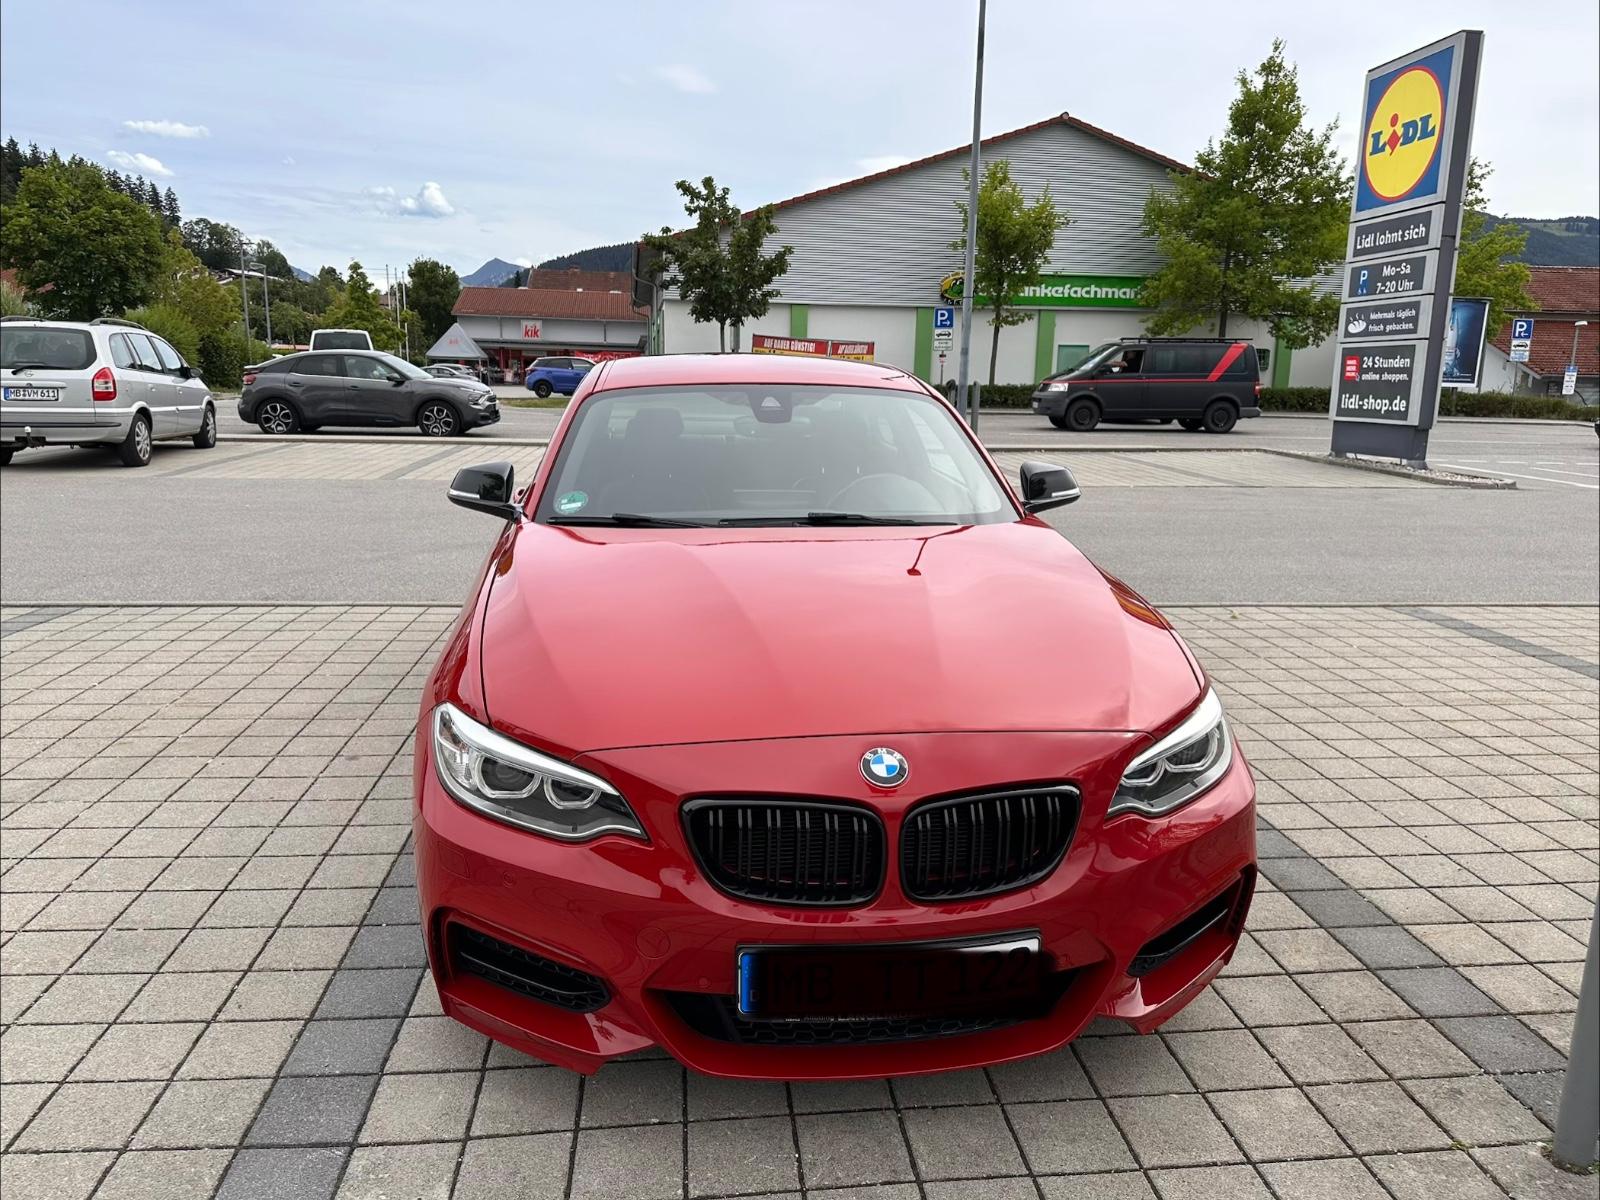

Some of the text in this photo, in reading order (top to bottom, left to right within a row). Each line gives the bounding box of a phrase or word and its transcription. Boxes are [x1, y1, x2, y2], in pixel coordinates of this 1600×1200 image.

[1356, 223, 1426, 249] Lidl lohnt sich
[1360, 262, 1411, 285] P Mo-Sa
[1376, 279, 1415, 294] 7-20 Uhr
[937, 310, 948, 326] P
[1369, 308, 1416, 320] Mehrmals täglich
[1368, 323, 1384, 332] frisch
[1515, 321, 1527, 337] P
[1362, 356, 1373, 368] 24
[1374, 355, 1410, 368] Stunden
[1361, 371, 1409, 383] online shoppen.
[9, 389, 57, 398] MB VM 611
[1341, 393, 1407, 414] lidl-shop.de
